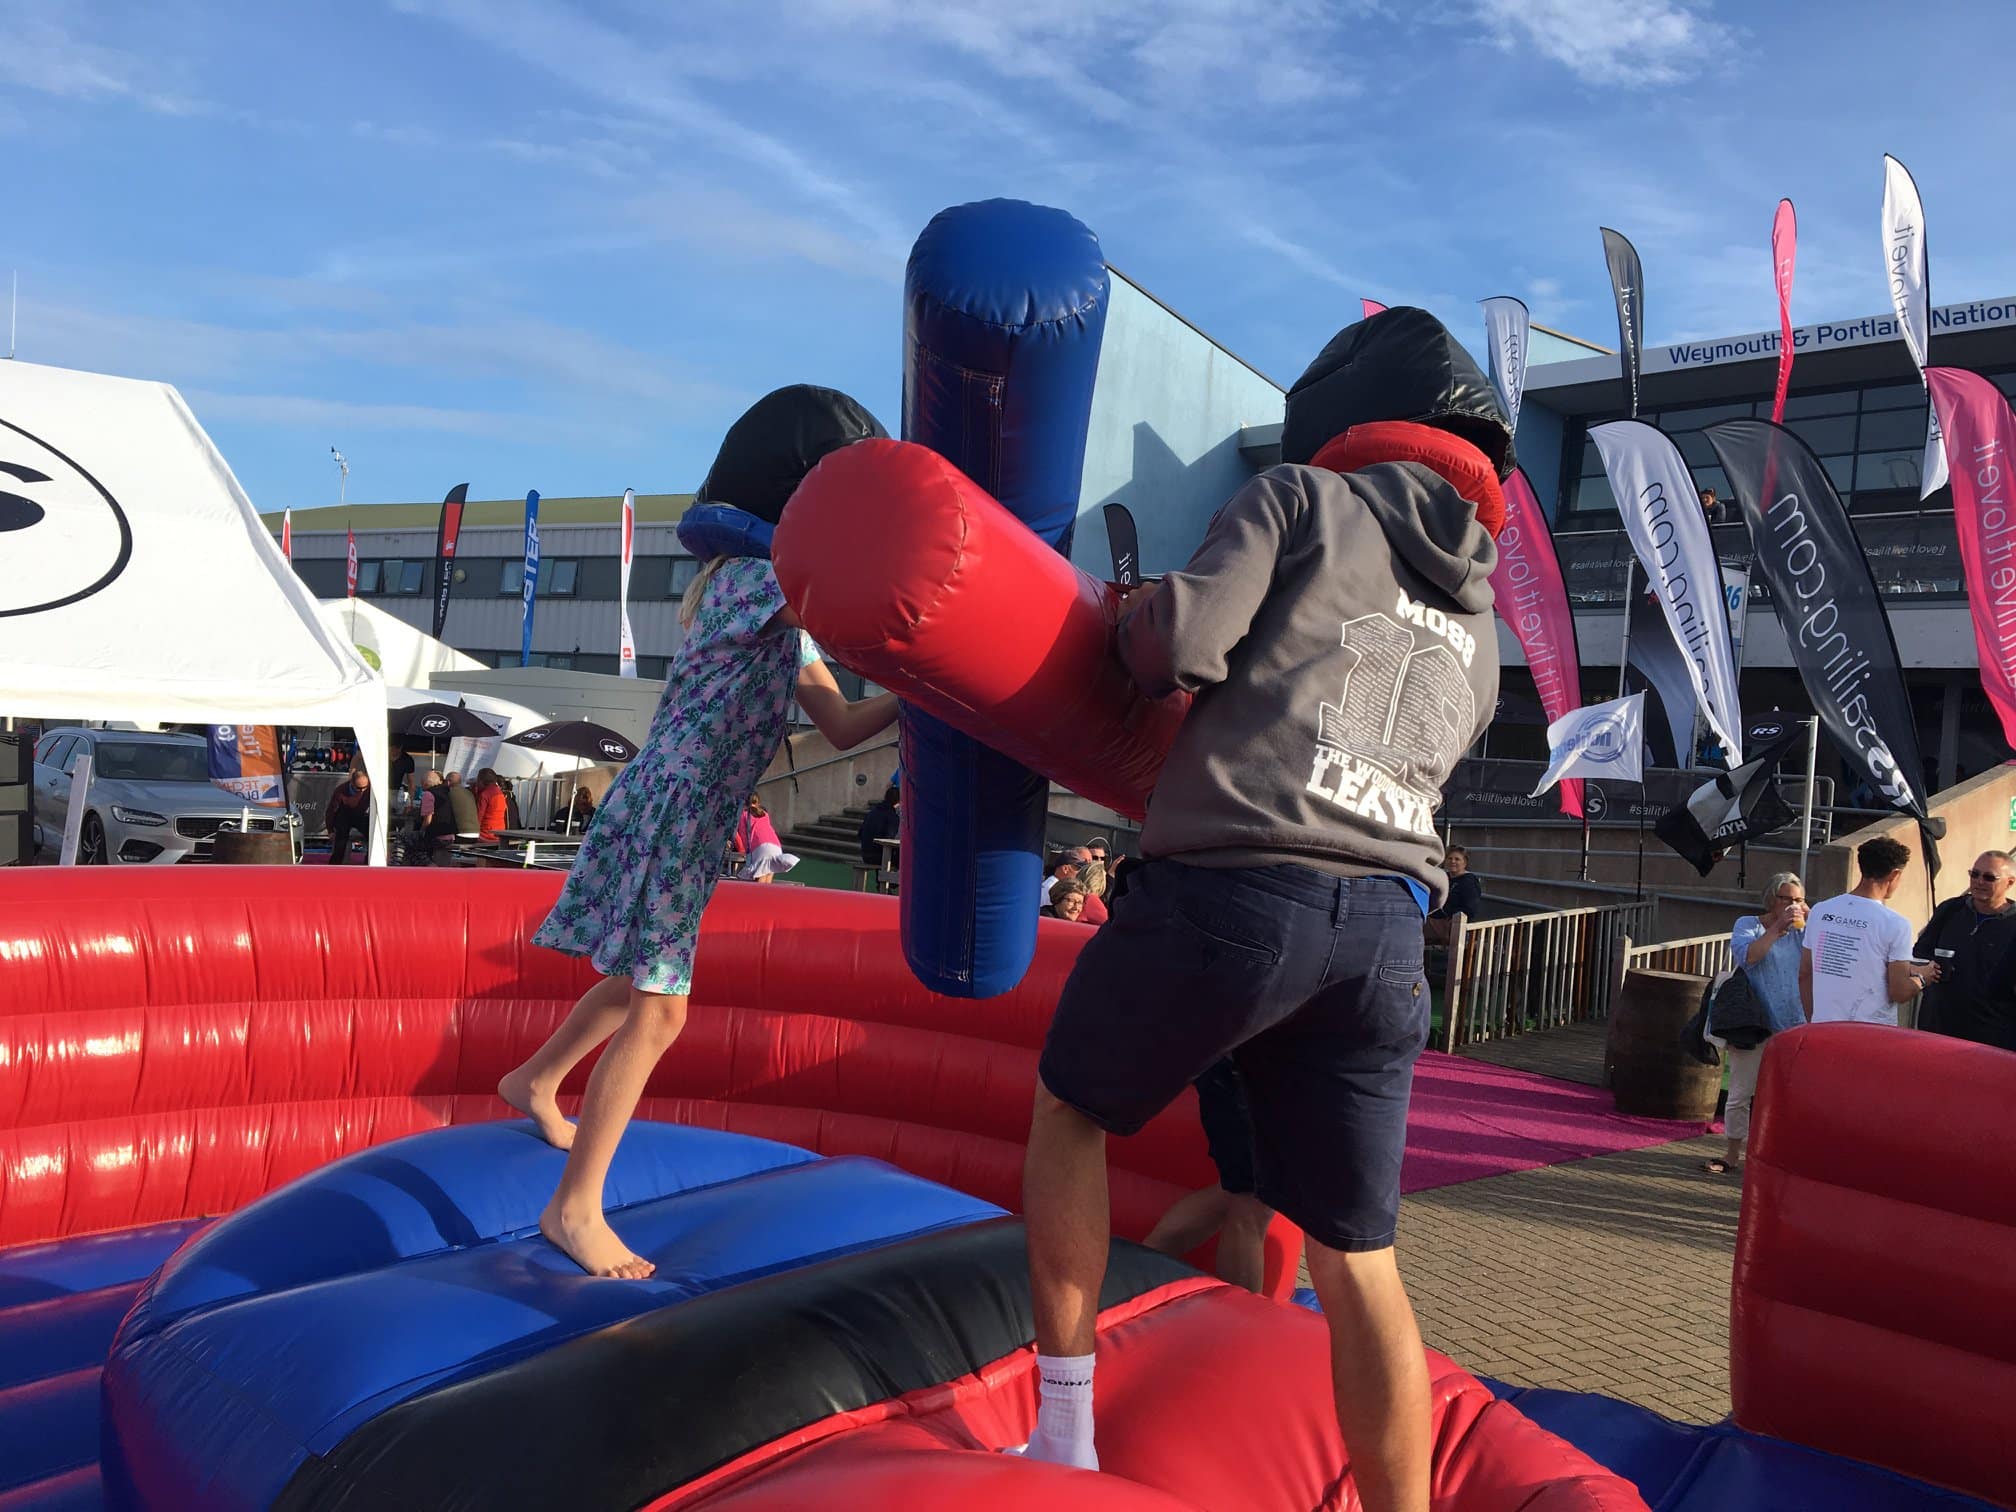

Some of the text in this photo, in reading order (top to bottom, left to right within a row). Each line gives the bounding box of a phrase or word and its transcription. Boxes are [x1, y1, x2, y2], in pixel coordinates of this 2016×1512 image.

[1669, 301, 2016, 364] Weymouth & Portla Nation
[424, 719, 448, 728] RS
[1752, 726, 1780, 736] RS
[604, 744, 624, 754] RS
[1315, 744, 1353, 769] THE
[1835, 916, 1869, 929] GAMES
